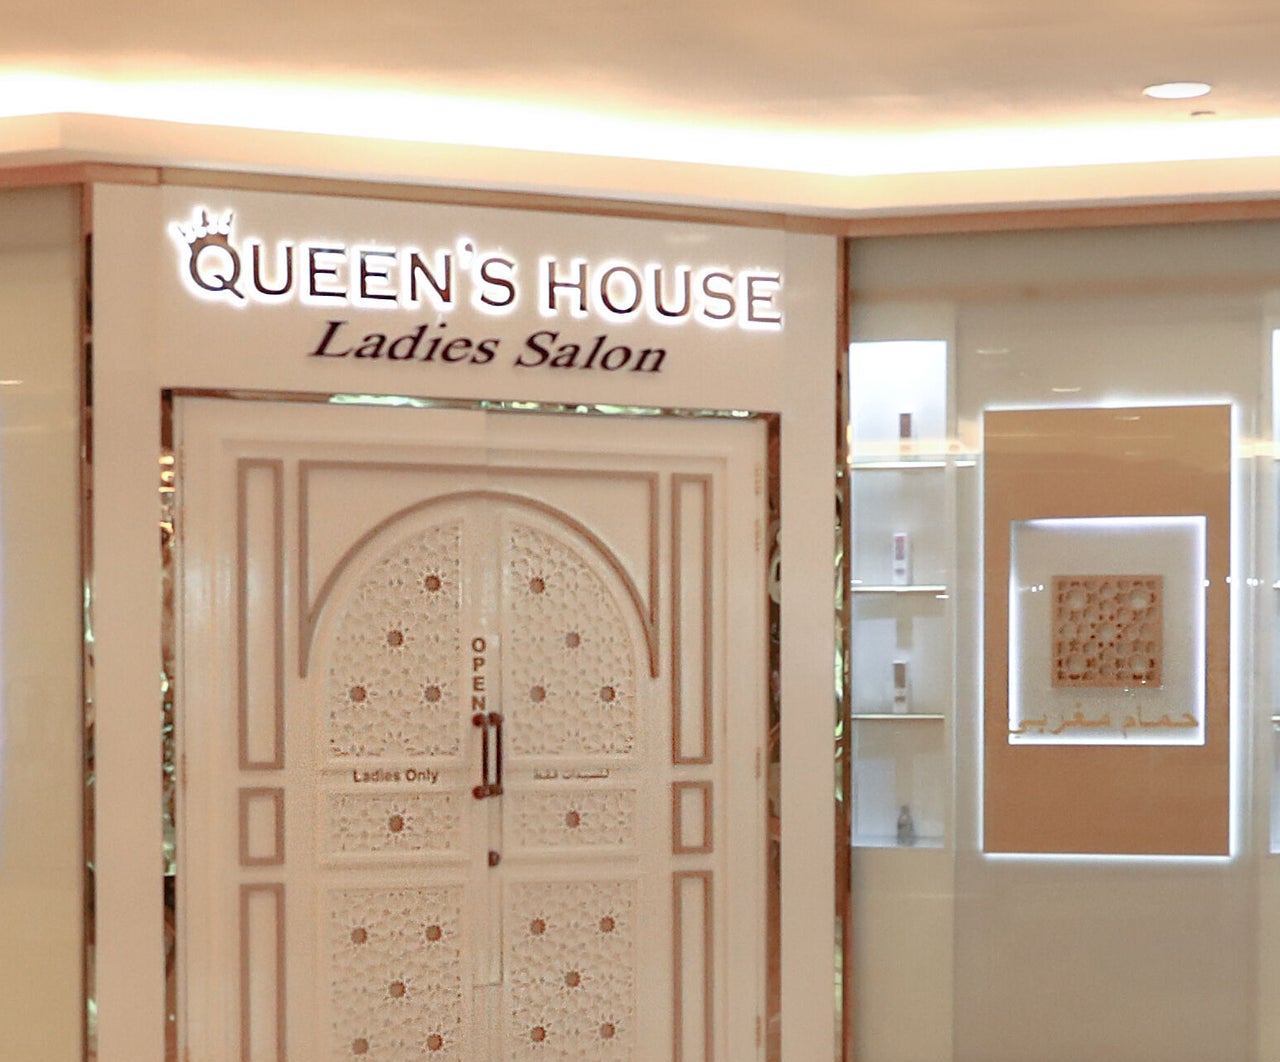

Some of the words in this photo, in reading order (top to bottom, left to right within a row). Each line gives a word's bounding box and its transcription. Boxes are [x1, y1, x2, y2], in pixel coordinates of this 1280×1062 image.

[182, 222, 517, 308] QUEEN'S
[546, 260, 783, 325] HOUSE
[310, 320, 500, 367] Ladies
[514, 331, 668, 374] Salon
[472, 637, 487, 711] OPEN
[353, 769, 401, 783] Ladies
[404, 769, 440, 784] Only
